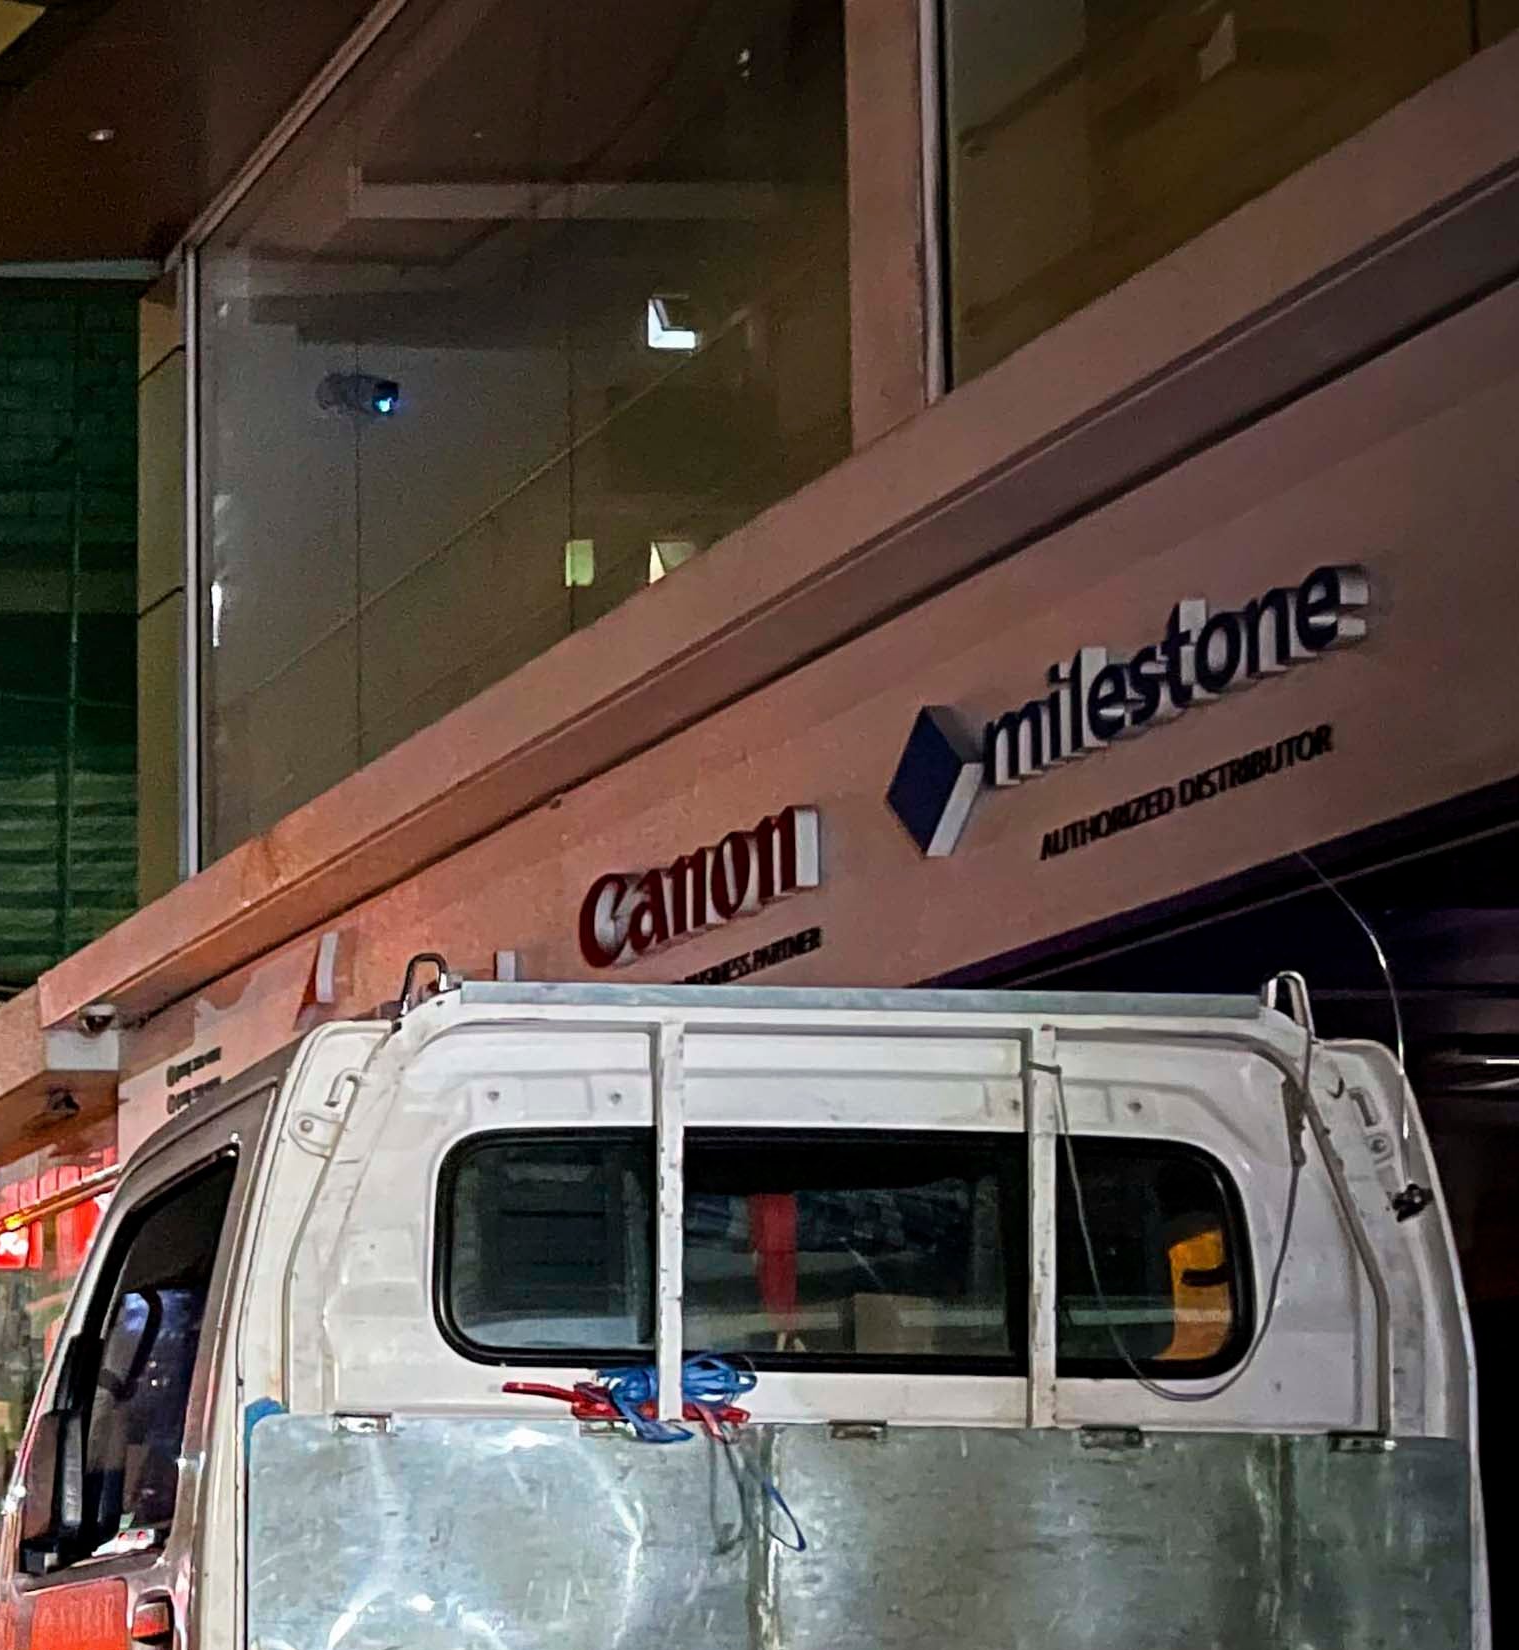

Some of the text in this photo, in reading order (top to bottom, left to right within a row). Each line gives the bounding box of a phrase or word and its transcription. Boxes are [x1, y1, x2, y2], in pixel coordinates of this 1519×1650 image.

[984, 564, 1367, 787] milestone
[1040, 724, 1334, 860] AUTHORIZED DISTRIBUTOR
[579, 805, 818, 969] Canon
